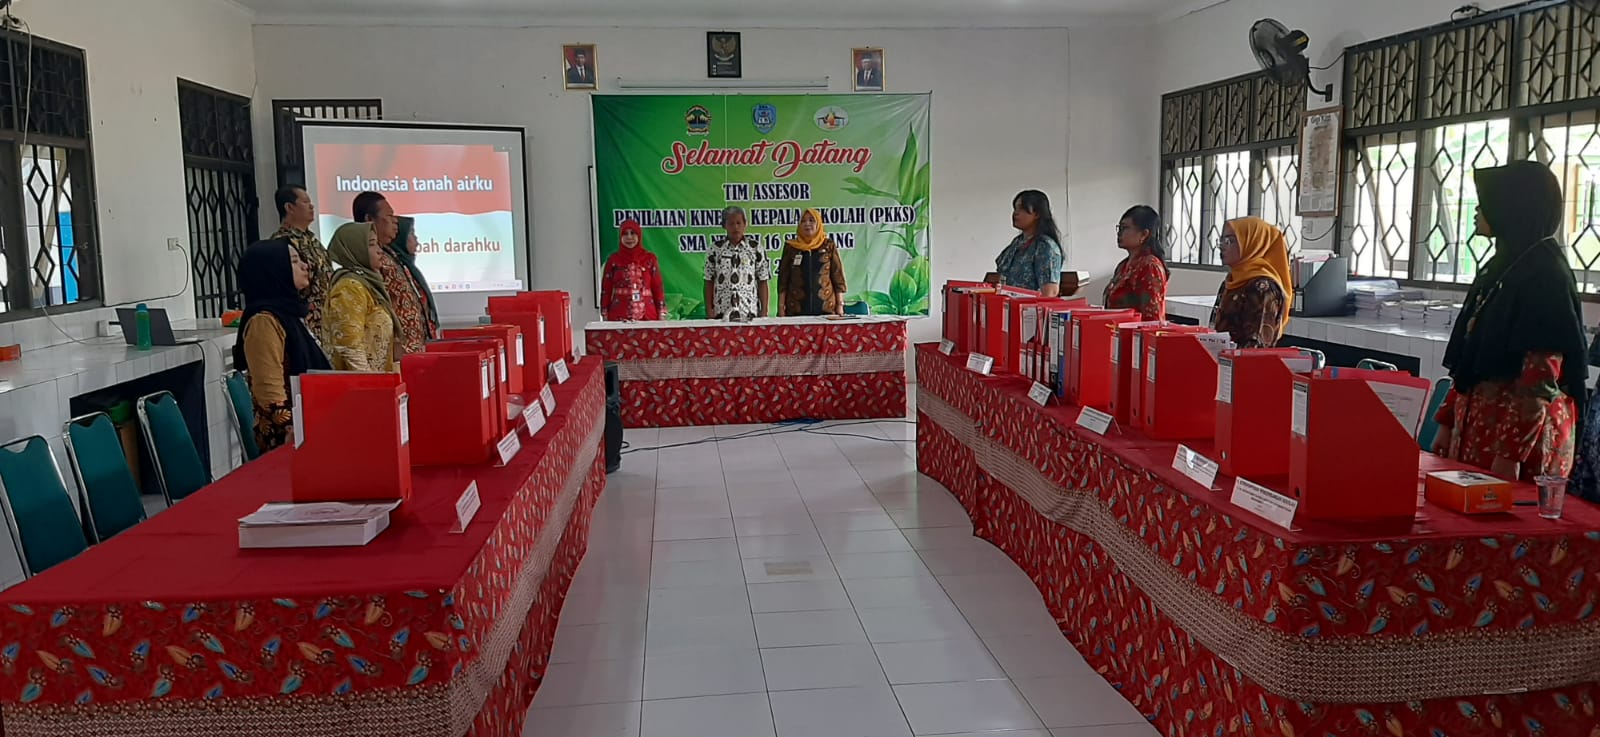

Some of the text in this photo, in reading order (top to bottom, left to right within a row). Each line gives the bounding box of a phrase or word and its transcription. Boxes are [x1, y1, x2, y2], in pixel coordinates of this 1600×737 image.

[662, 139, 872, 178] Selamat Datang
[337, 174, 493, 192] Indonesia tanah airku
[723, 182, 811, 200] TIM ASSESOR
[614, 209, 687, 226] PENILAIAN
[690, 209, 746, 226] KINE
[751, 208, 801, 226] KEPALA
[869, 206, 915, 225] (PKKS)
[444, 236, 501, 253] darahku
[679, 234, 707, 251] SMA
[764, 232, 781, 250] 16
